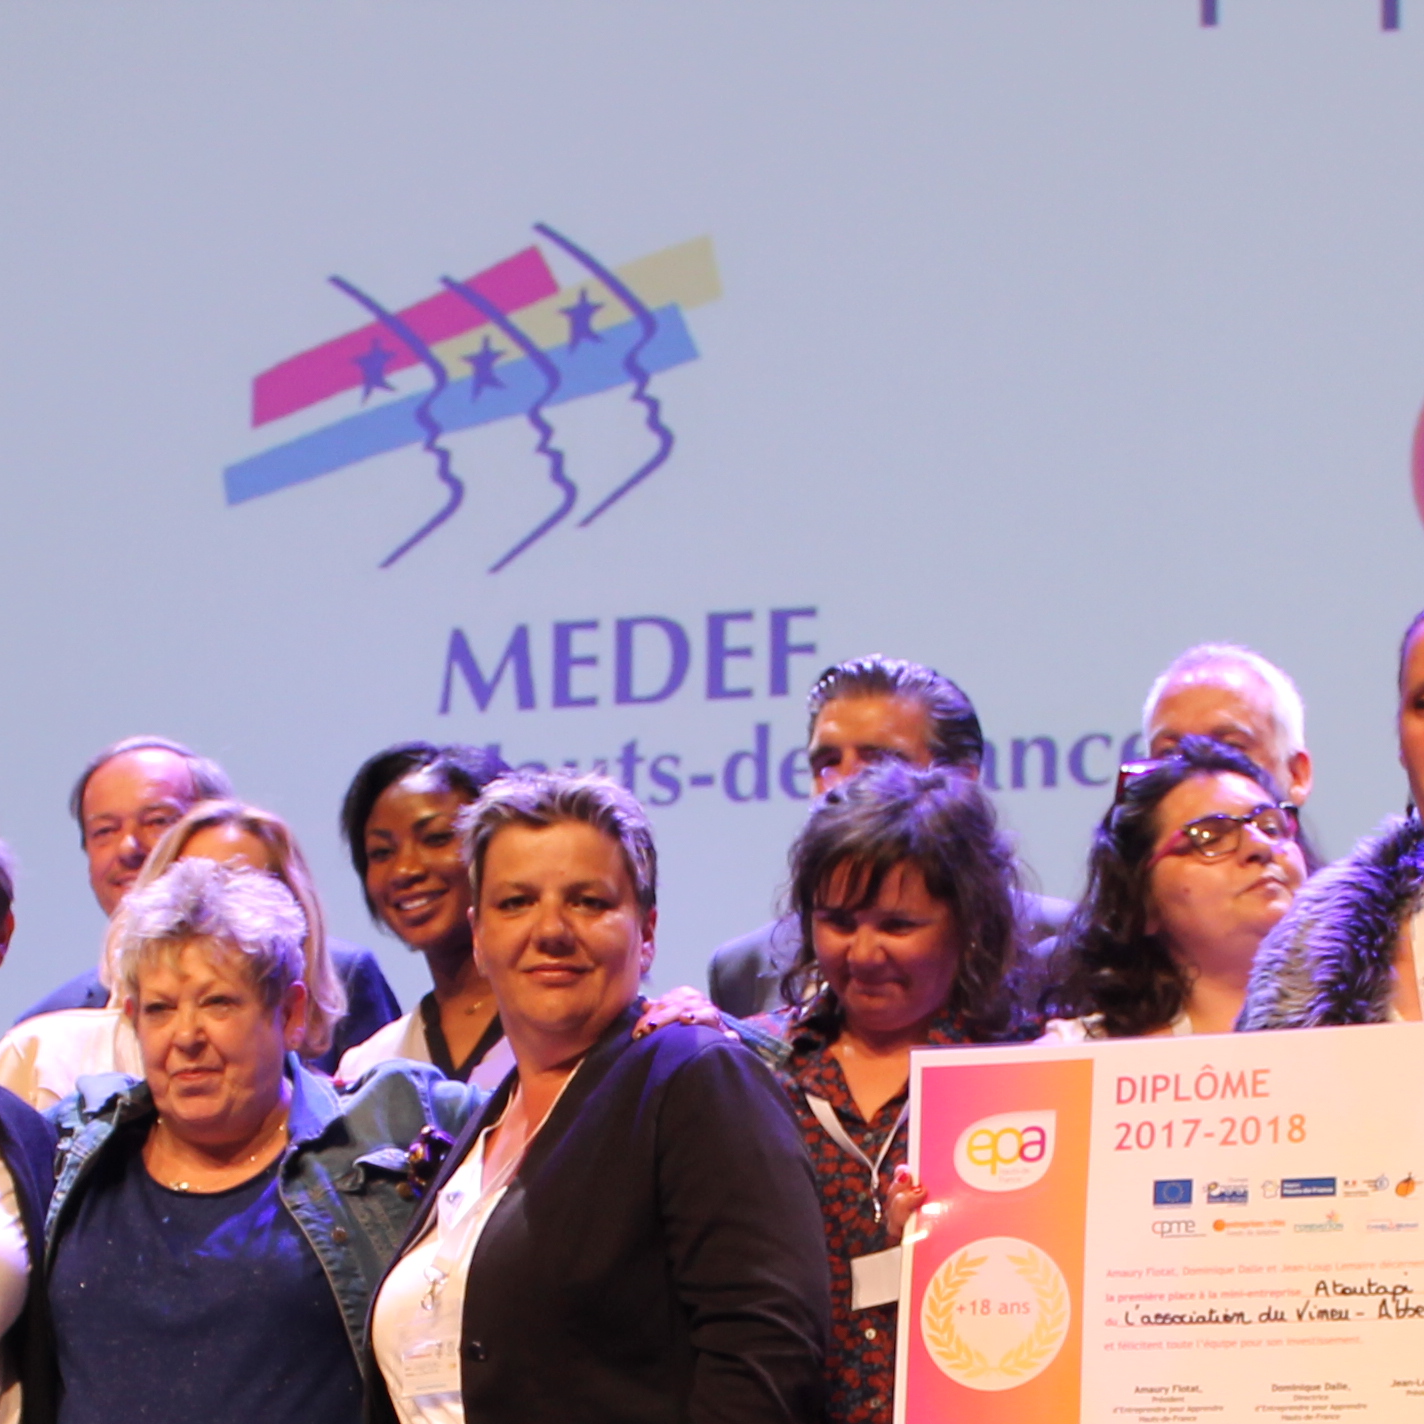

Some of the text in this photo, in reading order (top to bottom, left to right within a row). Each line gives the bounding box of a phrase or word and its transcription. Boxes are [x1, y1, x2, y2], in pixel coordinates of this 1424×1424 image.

[437, 606, 819, 715] MEDEF
[1115, 1064, 1272, 1105] DIPLÔME
[966, 1125, 1046, 1176] epa
[1113, 1114, 1308, 1151] 2017-2018
[957, 1299, 1032, 1316] +18 ans
[1258, 1305, 1287, 1323] du
